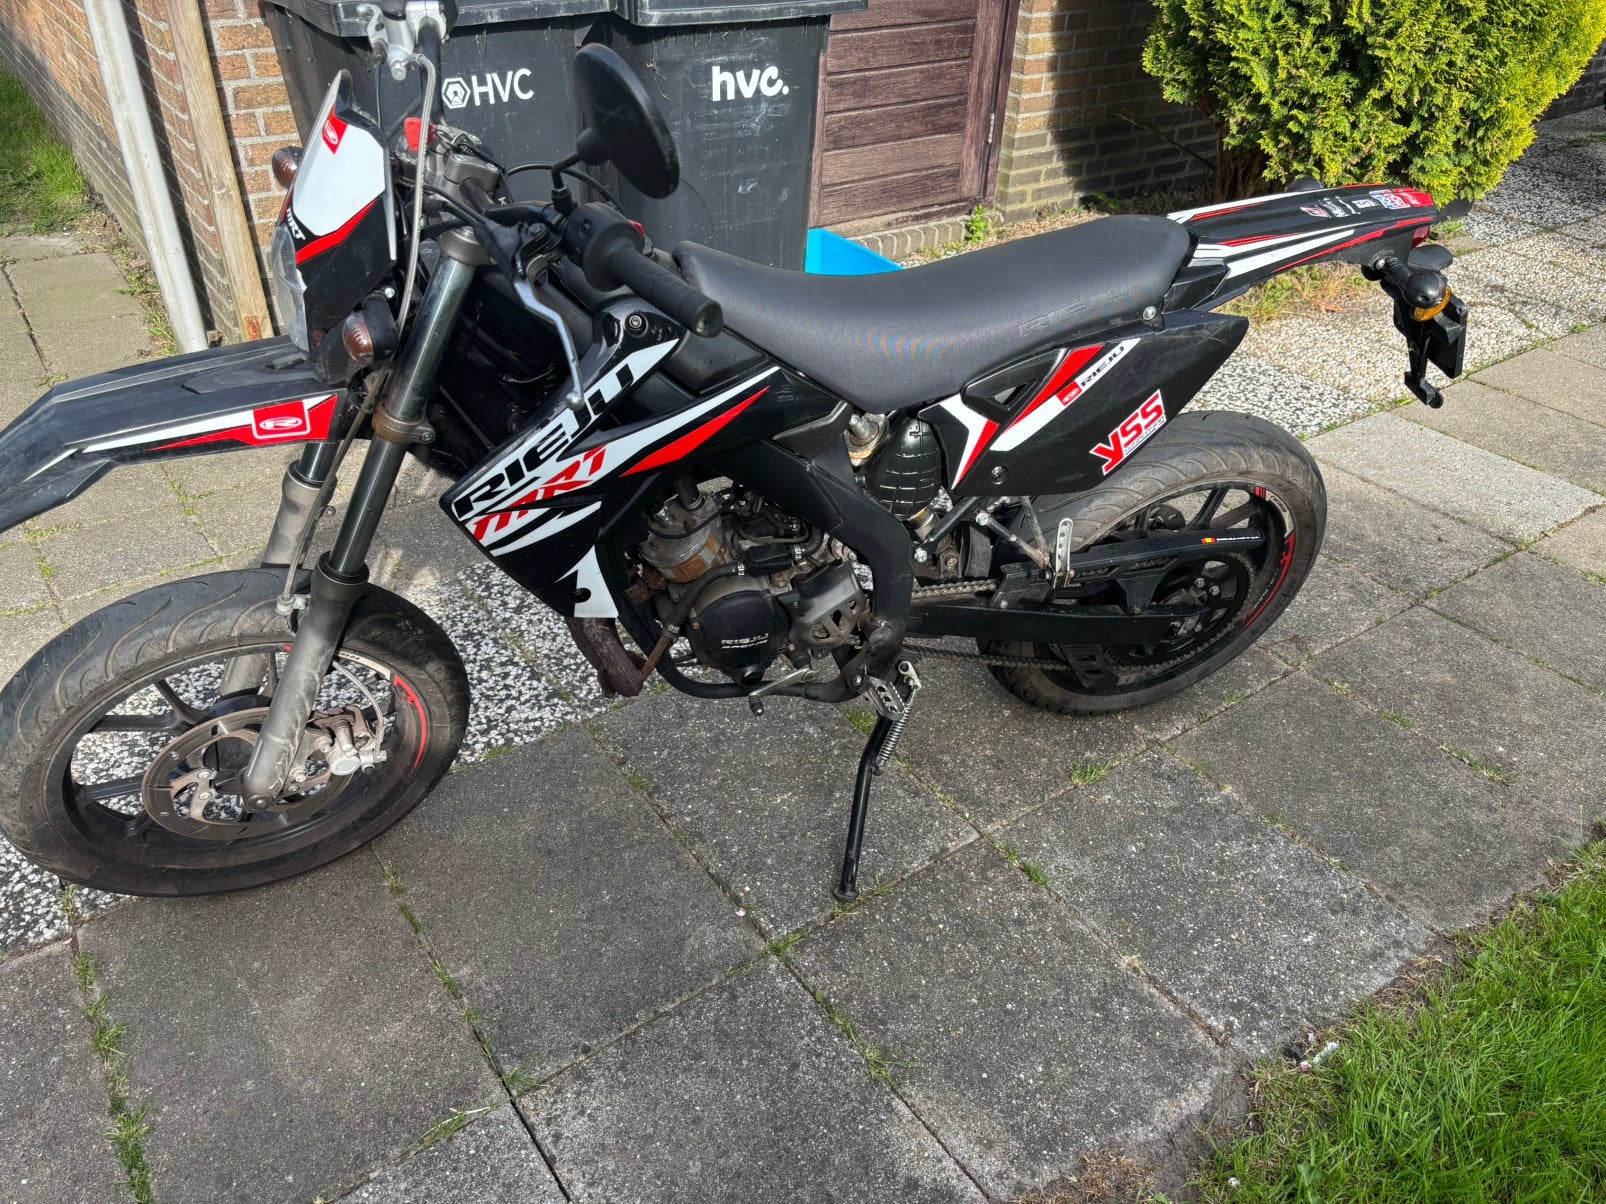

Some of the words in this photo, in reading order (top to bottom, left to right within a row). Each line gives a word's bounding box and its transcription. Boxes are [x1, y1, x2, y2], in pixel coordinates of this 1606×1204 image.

[471, 68, 535, 106] HVC
[711, 65, 790, 102] hvc.
[1081, 345, 1125, 387] RIEJU
[453, 363, 634, 520] RIEJU
[1092, 392, 1164, 474] YSS
